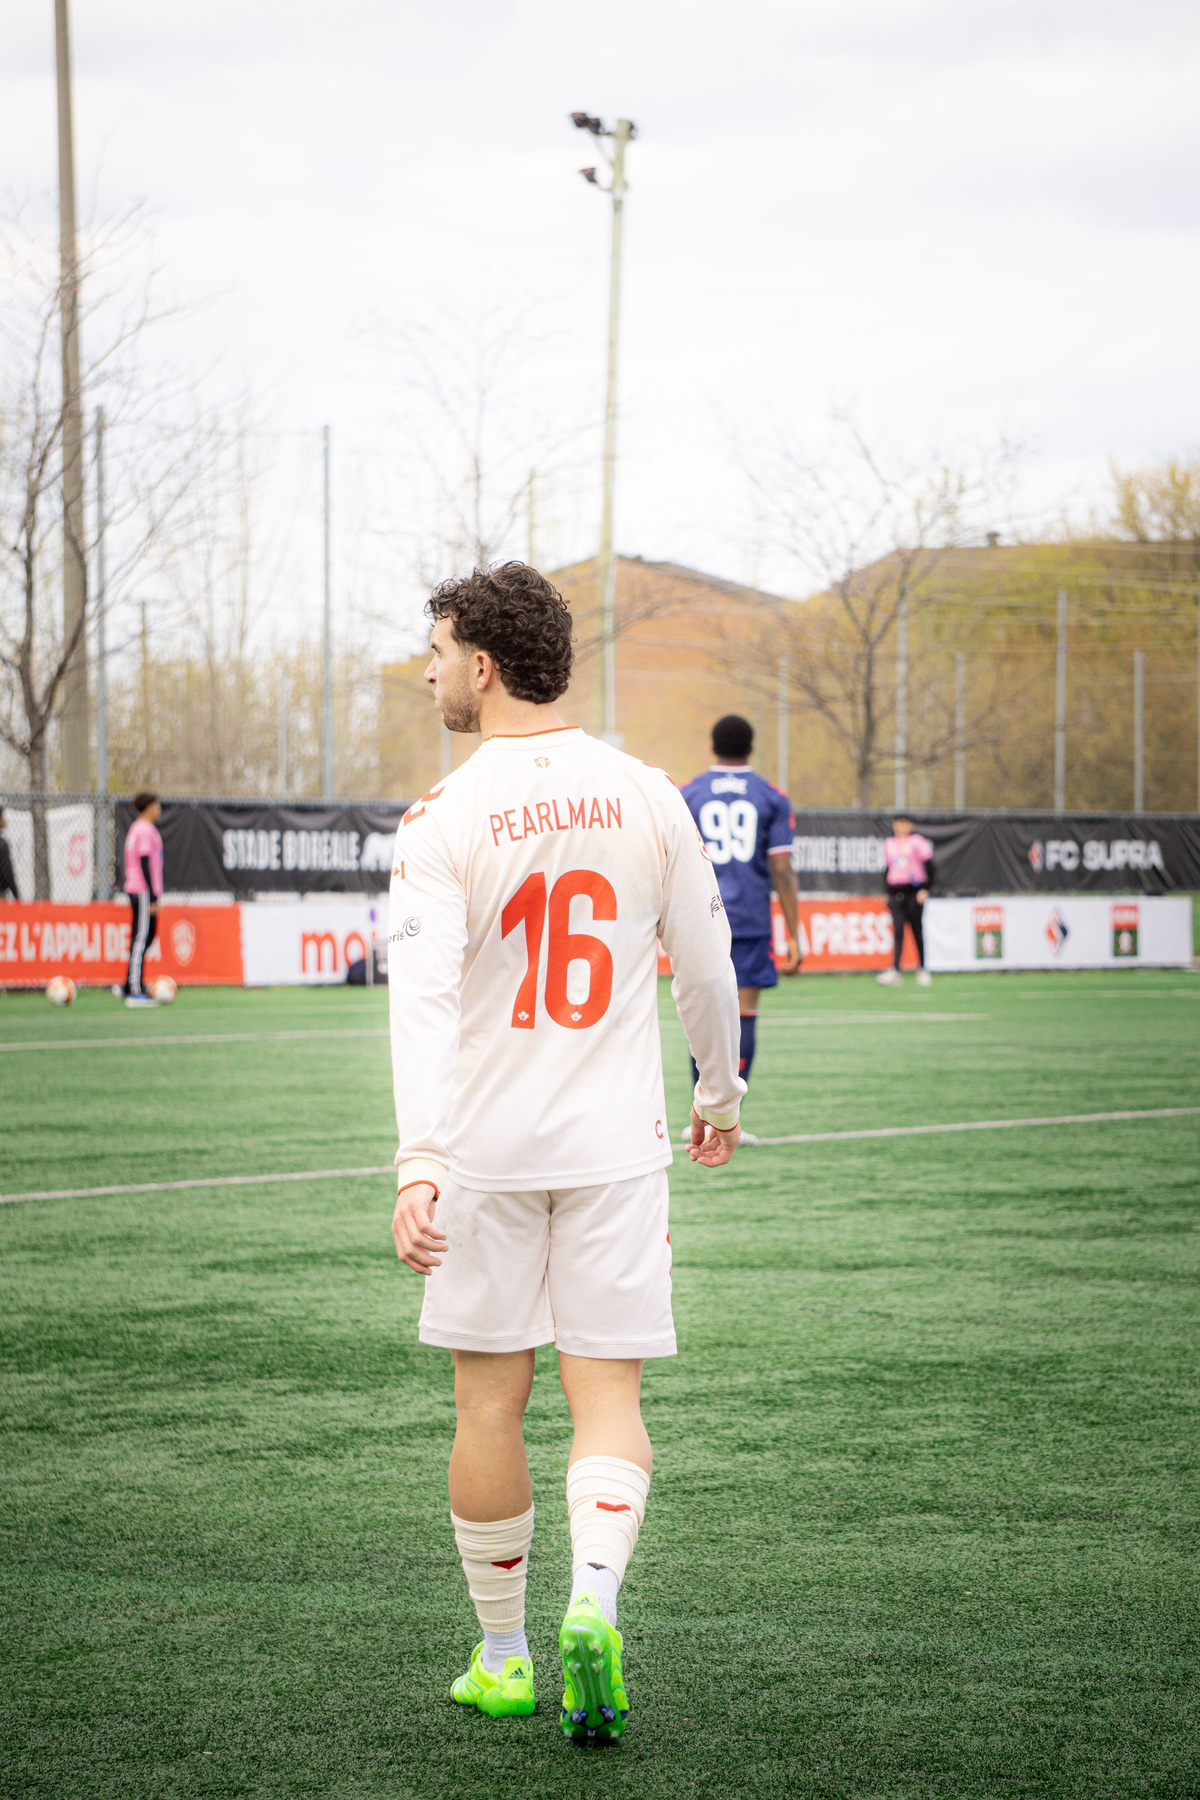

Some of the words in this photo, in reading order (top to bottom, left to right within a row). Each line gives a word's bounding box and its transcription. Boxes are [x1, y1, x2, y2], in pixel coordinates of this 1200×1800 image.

[489, 797, 622, 846] PEARLMAN
[698, 799, 758, 865] 99
[222, 828, 281, 870] STADE
[1045, 839, 1080, 871] FC
[1082, 839, 1165, 871] SUPRA
[104, 921, 131, 962] DE
[501, 869, 617, 1029] 16
